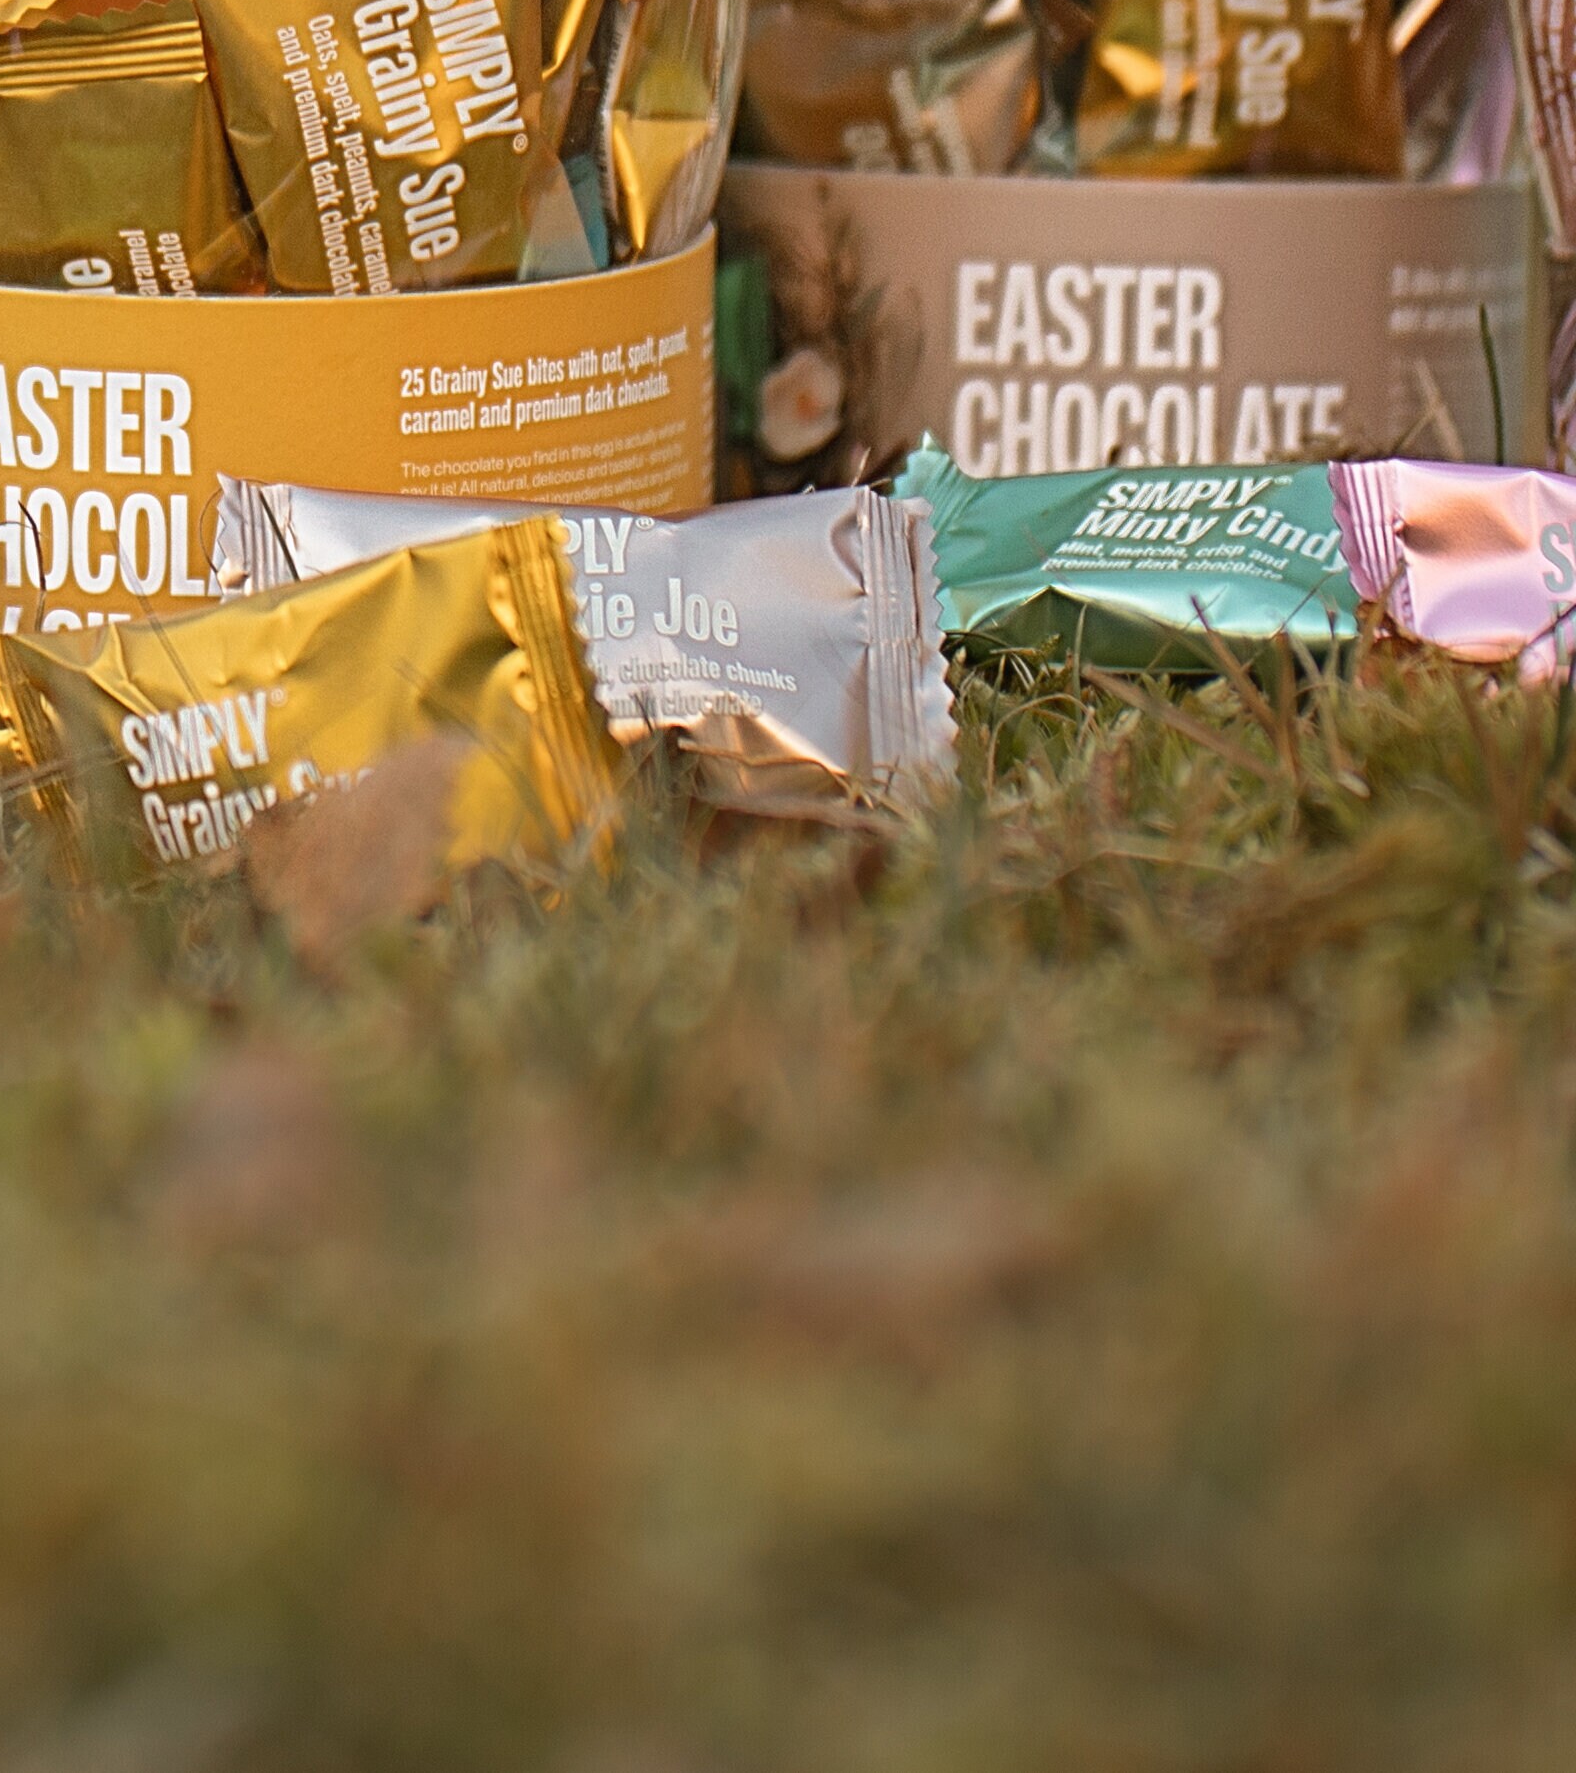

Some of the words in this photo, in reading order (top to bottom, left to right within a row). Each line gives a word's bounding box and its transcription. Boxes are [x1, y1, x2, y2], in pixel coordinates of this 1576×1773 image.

[277, 25, 310, 67] and
[308, 14, 338, 71] Oats,
[323, 70, 362, 133] spelt,
[1235, 28, 1304, 125] Sue
[283, 66, 329, 161] premium
[310, 159, 345, 210] dark
[335, 131, 381, 222] peanuts,
[398, 162, 466, 261] Sue
[956, 262, 1221, 369] EASTER
[400, 367, 425, 398] 25
[430, 365, 489, 405] Grainy
[492, 360, 524, 391] Sue
[527, 356, 565, 387] bites
[568, 347, 598, 380] with
[602, 344, 625, 376] oat,
[400, 402, 475, 435] caramel
[479, 397, 512, 428] and
[515, 390, 583, 432] premium
[585, 382, 615, 415] dark
[401, 462, 430, 479] The
[433, 459, 505, 477] chocolate
[507, 455, 531, 473] you
[532, 447, 558, 468] find
[559, 446, 570, 462] in
[571, 442, 593, 461] this
[593, 438, 614, 459] egg
[460, 479, 478, 496] All
[480, 476, 529, 494] natural,
[532, 468, 585, 489] delicious
[587, 464, 608, 481] and
[1073, 509, 1220, 546] Minty
[1134, 558, 1181, 571] dark
[1184, 559, 1284, 582] chocolate
[1195, 543, 1246, 559] crisp
[1248, 549, 1290, 571] and
[653, 577, 740, 648] Joe
[618, 653, 721, 684] chocolate
[726, 660, 798, 693] chunks
